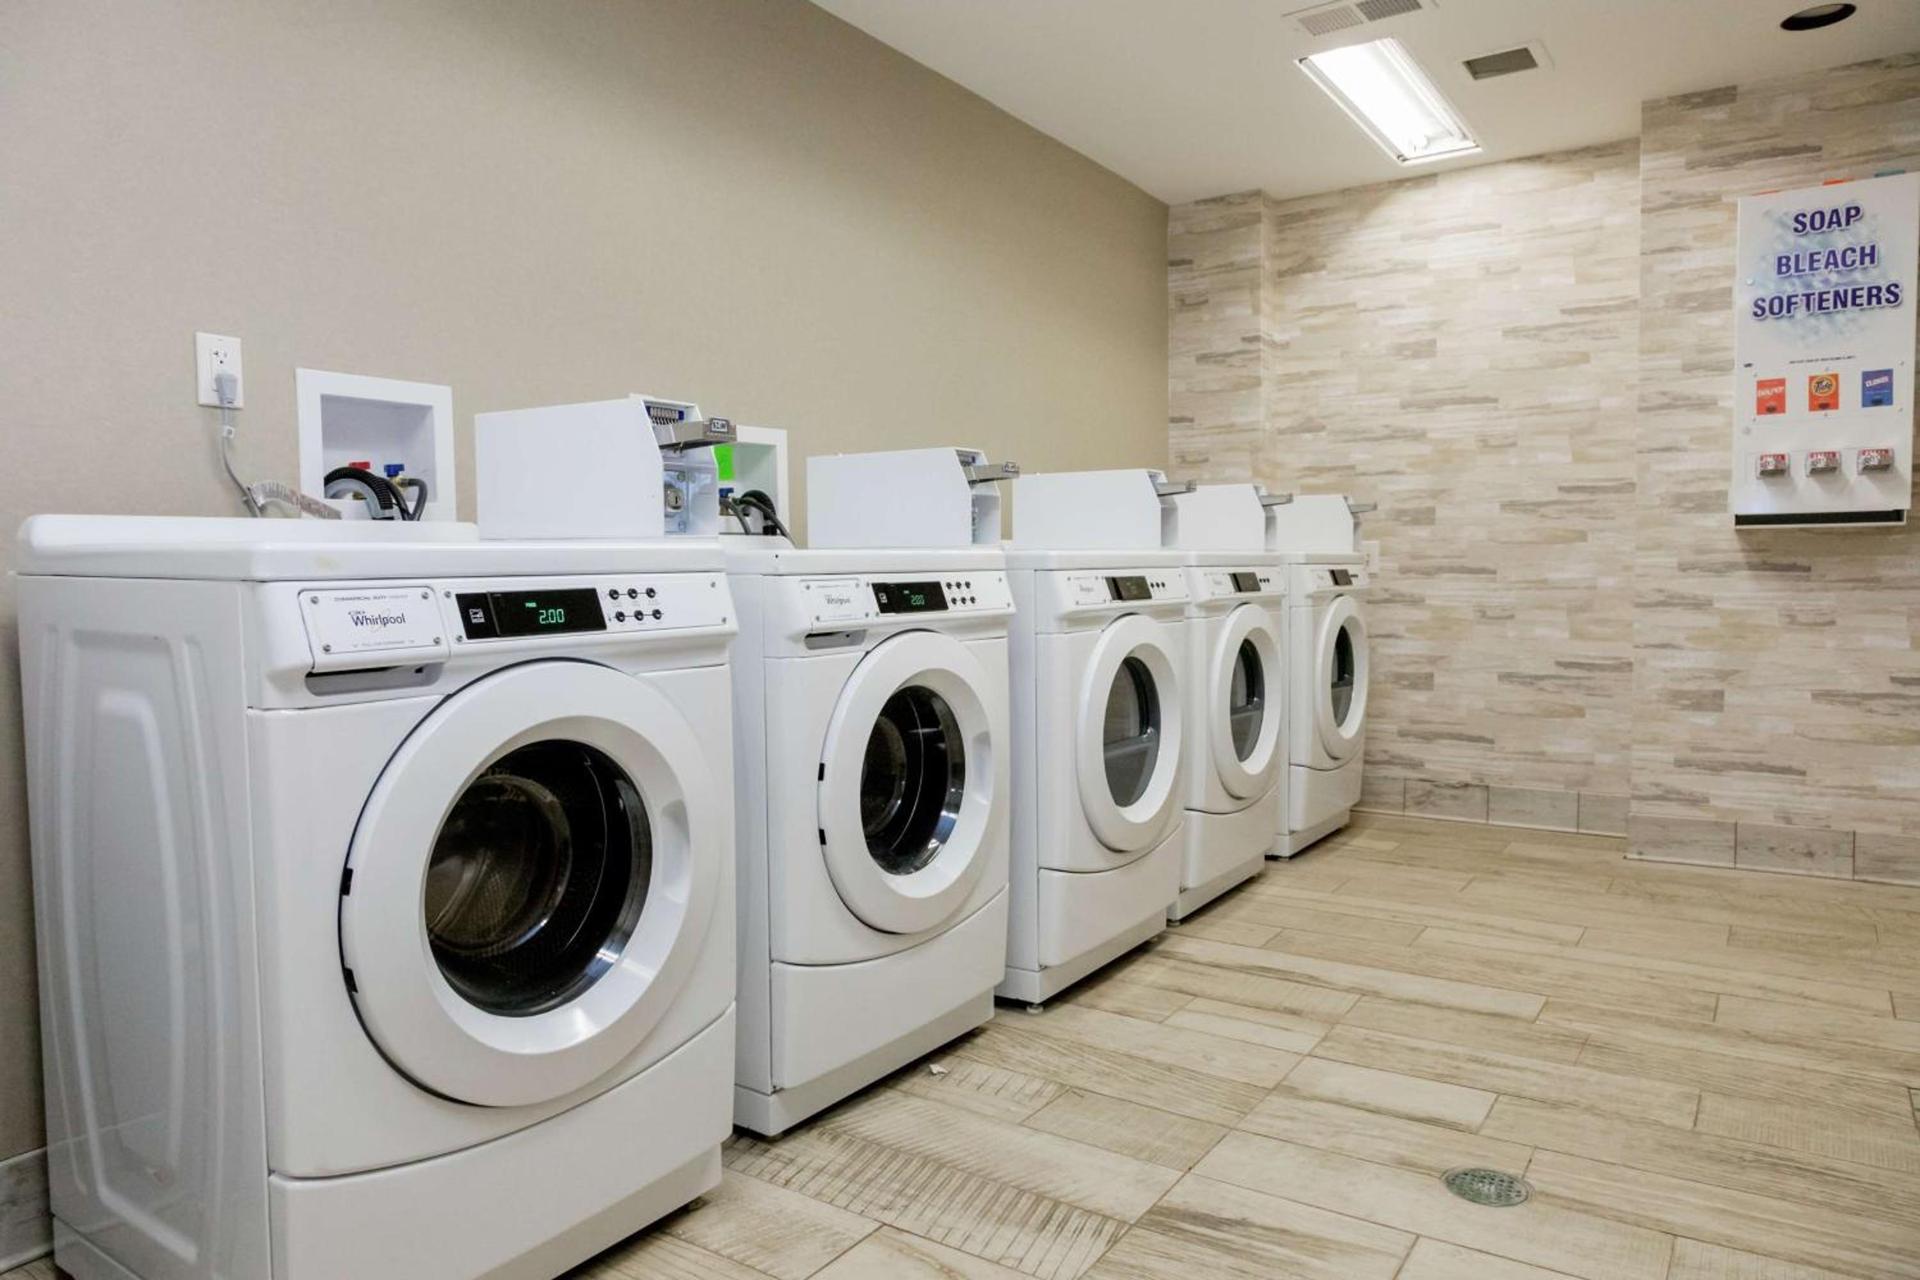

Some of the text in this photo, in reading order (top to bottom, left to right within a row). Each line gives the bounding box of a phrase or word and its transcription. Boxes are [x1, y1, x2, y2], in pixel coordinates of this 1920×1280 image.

[1793, 206, 1862, 234] SOAP
[1776, 244, 1877, 276] BLEACH
[1752, 283, 1901, 319] SOFTENERS
[350, 612, 407, 628] Whirlpool
[538, 607, 565, 624] 2.00
